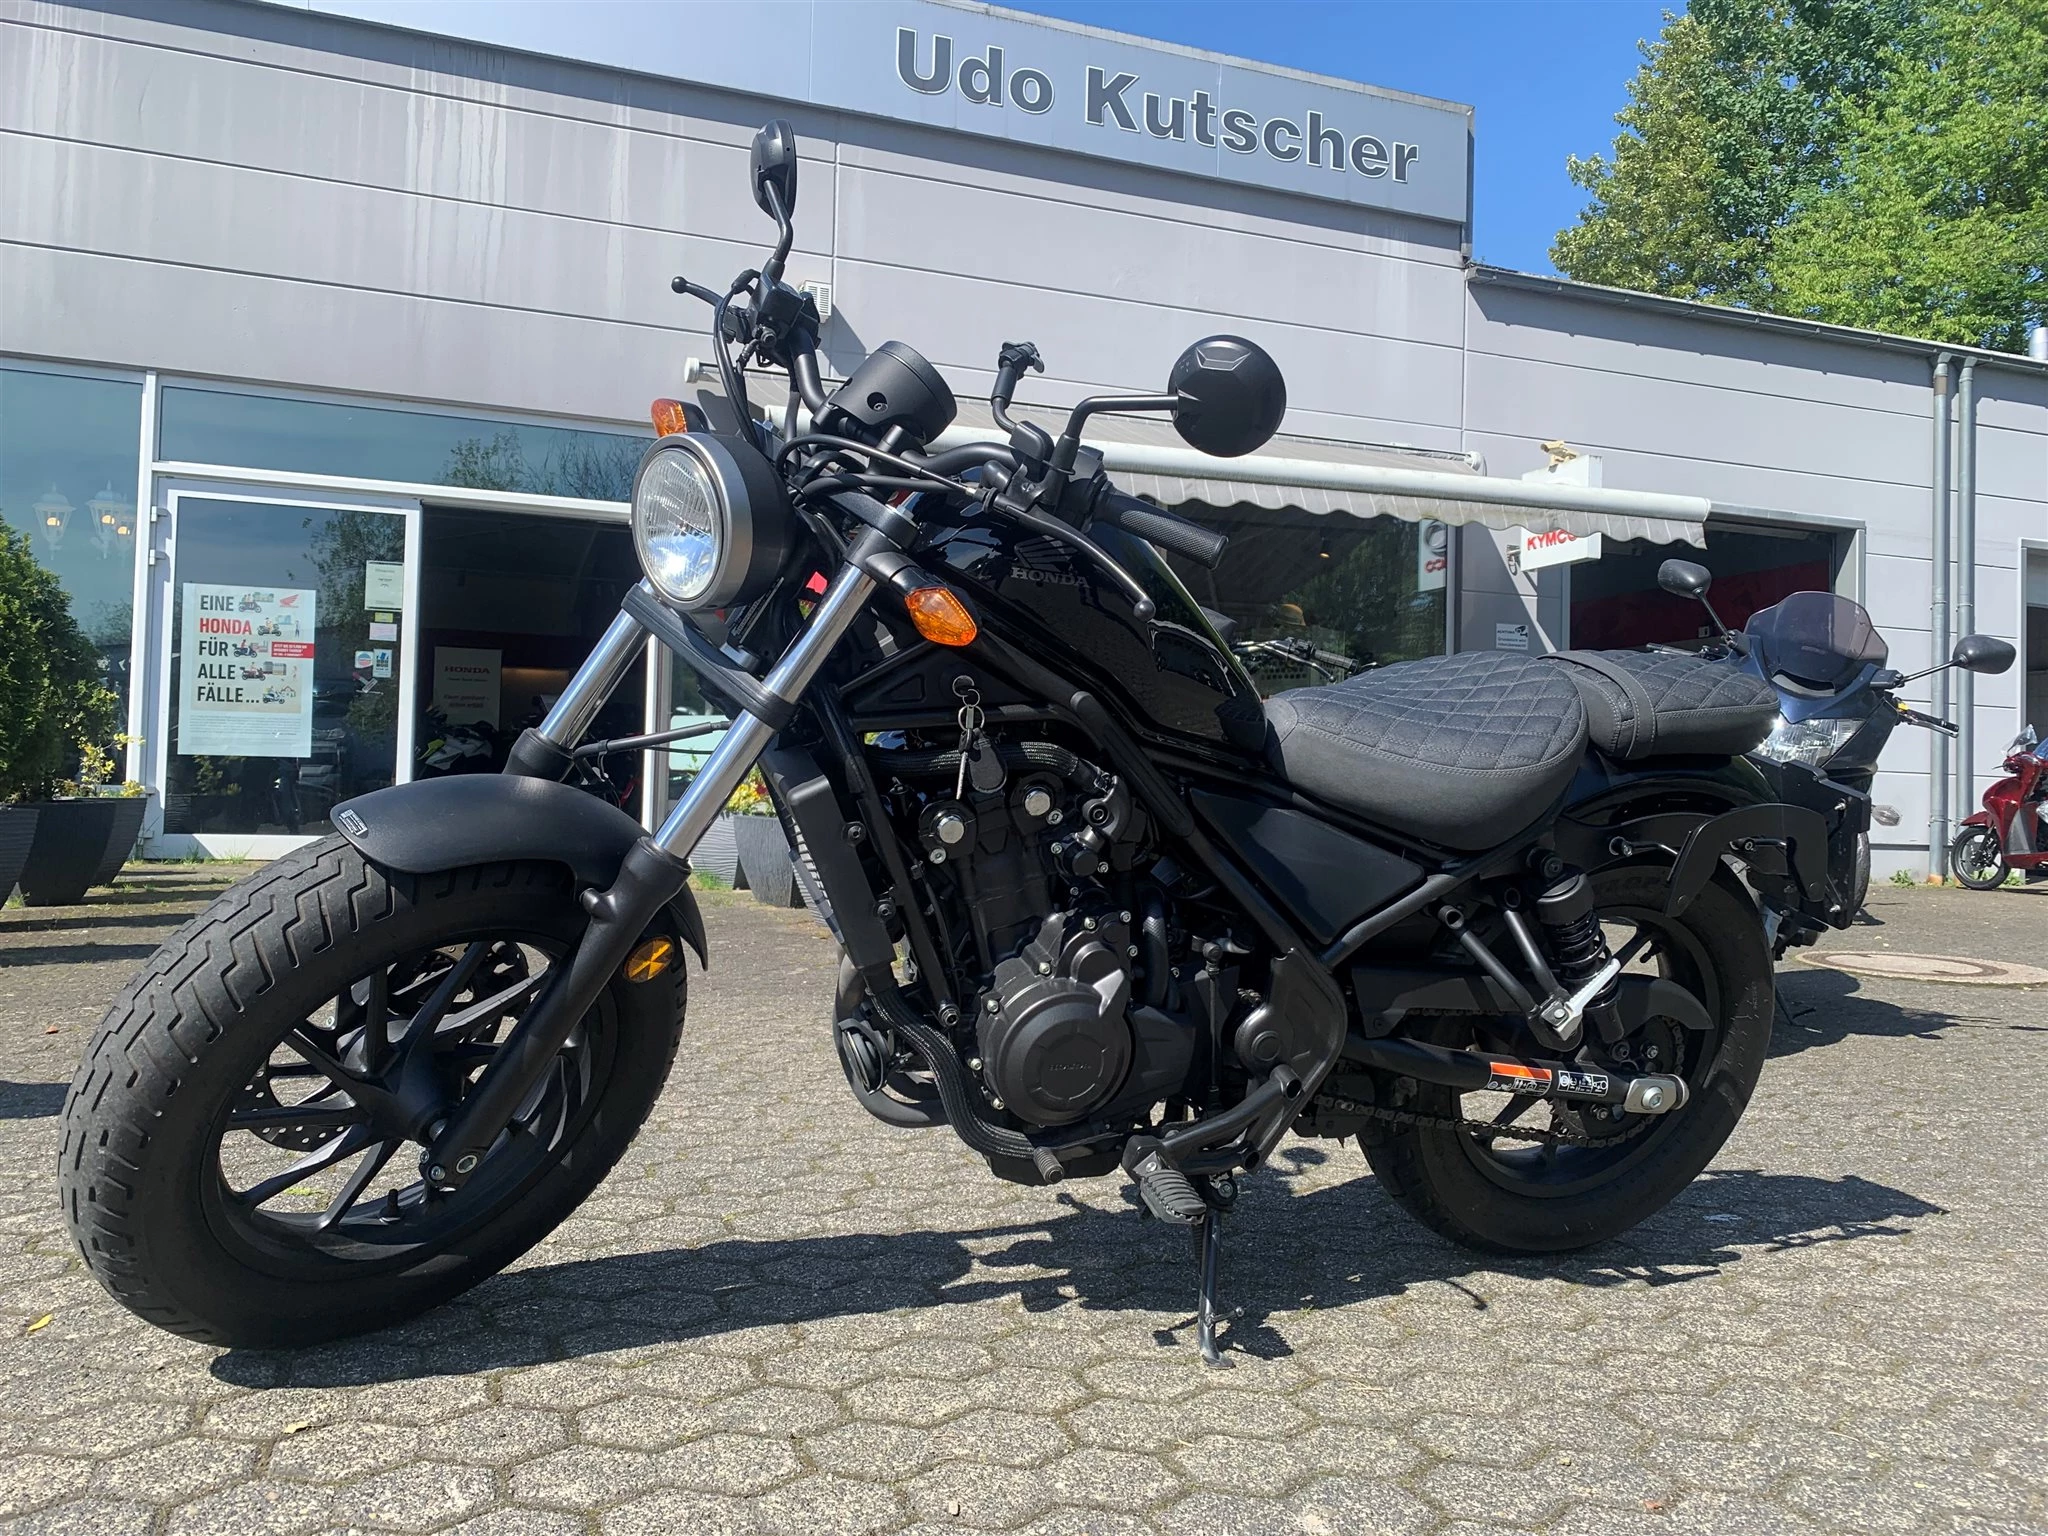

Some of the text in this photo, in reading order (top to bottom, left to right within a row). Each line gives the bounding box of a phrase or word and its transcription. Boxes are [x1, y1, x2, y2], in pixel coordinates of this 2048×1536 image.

[896, 26, 1419, 182] Udo Kutscher
[1010, 567, 1090, 588] HONDA
[200, 595, 235, 612] EINE
[199, 617, 252, 635] HONDA
[198, 636, 229, 657] FÜR
[197, 663, 236, 680] ALLE
[444, 665, 491, 675] HONDA
